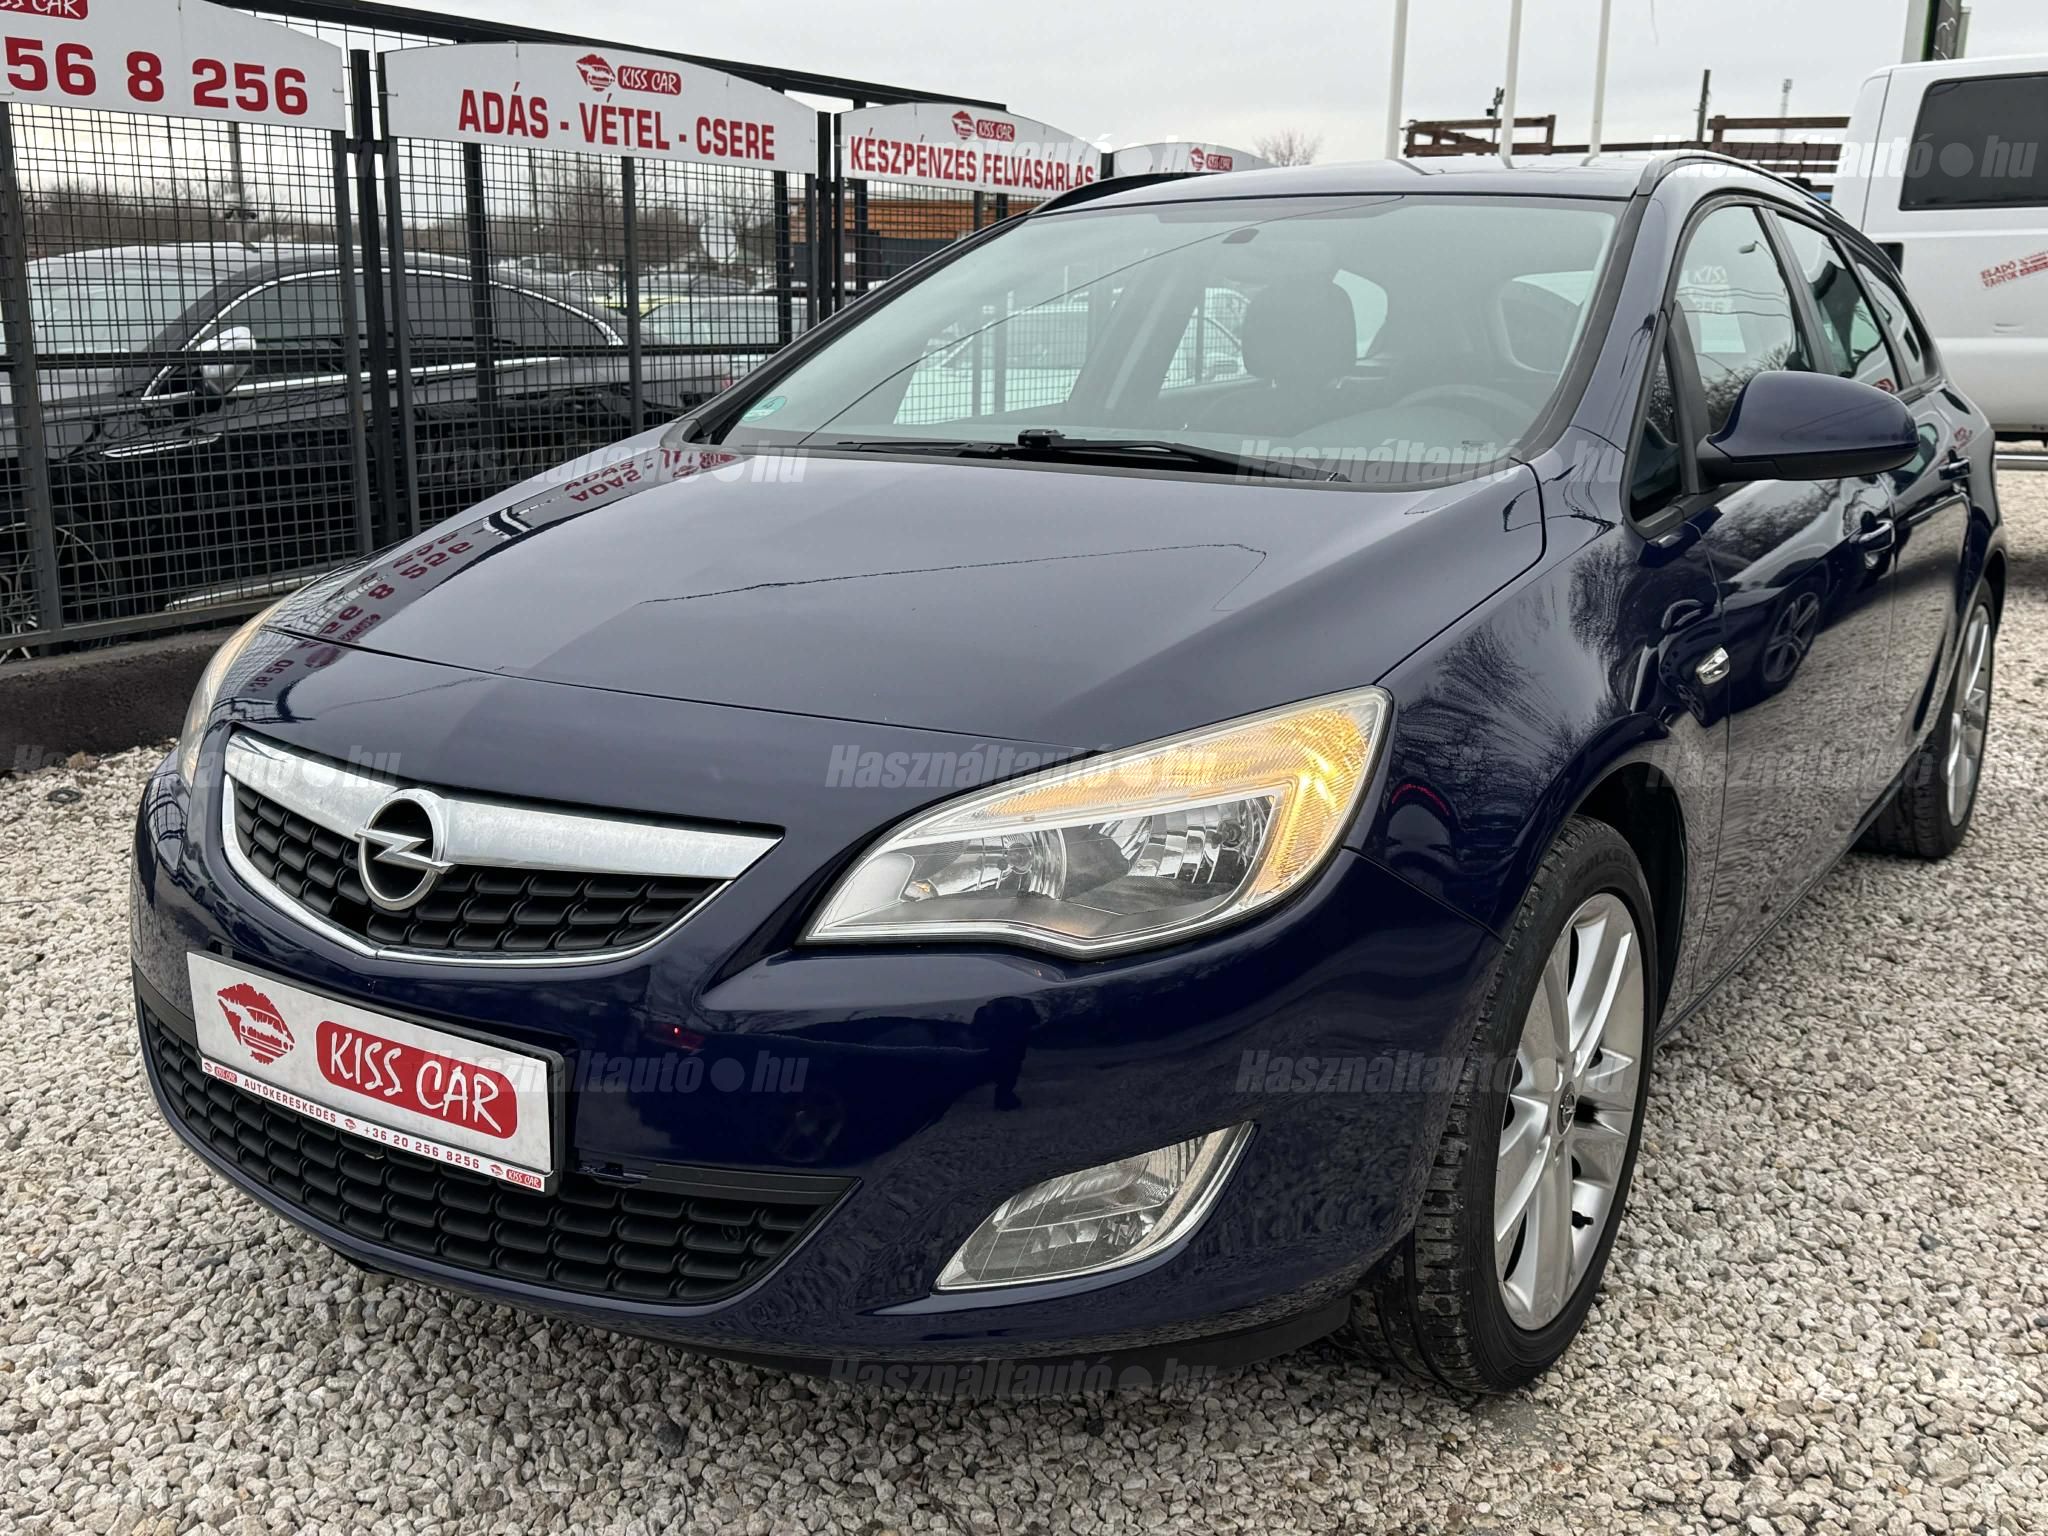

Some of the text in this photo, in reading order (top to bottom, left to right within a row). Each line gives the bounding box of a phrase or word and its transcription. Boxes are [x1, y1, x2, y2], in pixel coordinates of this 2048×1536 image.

[126, 51, 165, 102] 8
[192, 59, 309, 115] 256
[622, 68, 678, 94] KISS CAR
[458, 81, 549, 139] ADÁS
[579, 93, 671, 150] VÉTEL
[696, 116, 776, 161] CSERE
[850, 127, 1095, 191] KÉSZPÉNZES FELVÁSÁRLÁS
[330, 1031, 502, 1134] KISS CAR
[364, 1126, 480, 1169] +36 20 256 8256
[508, 1170, 541, 1188] KISS CAR
